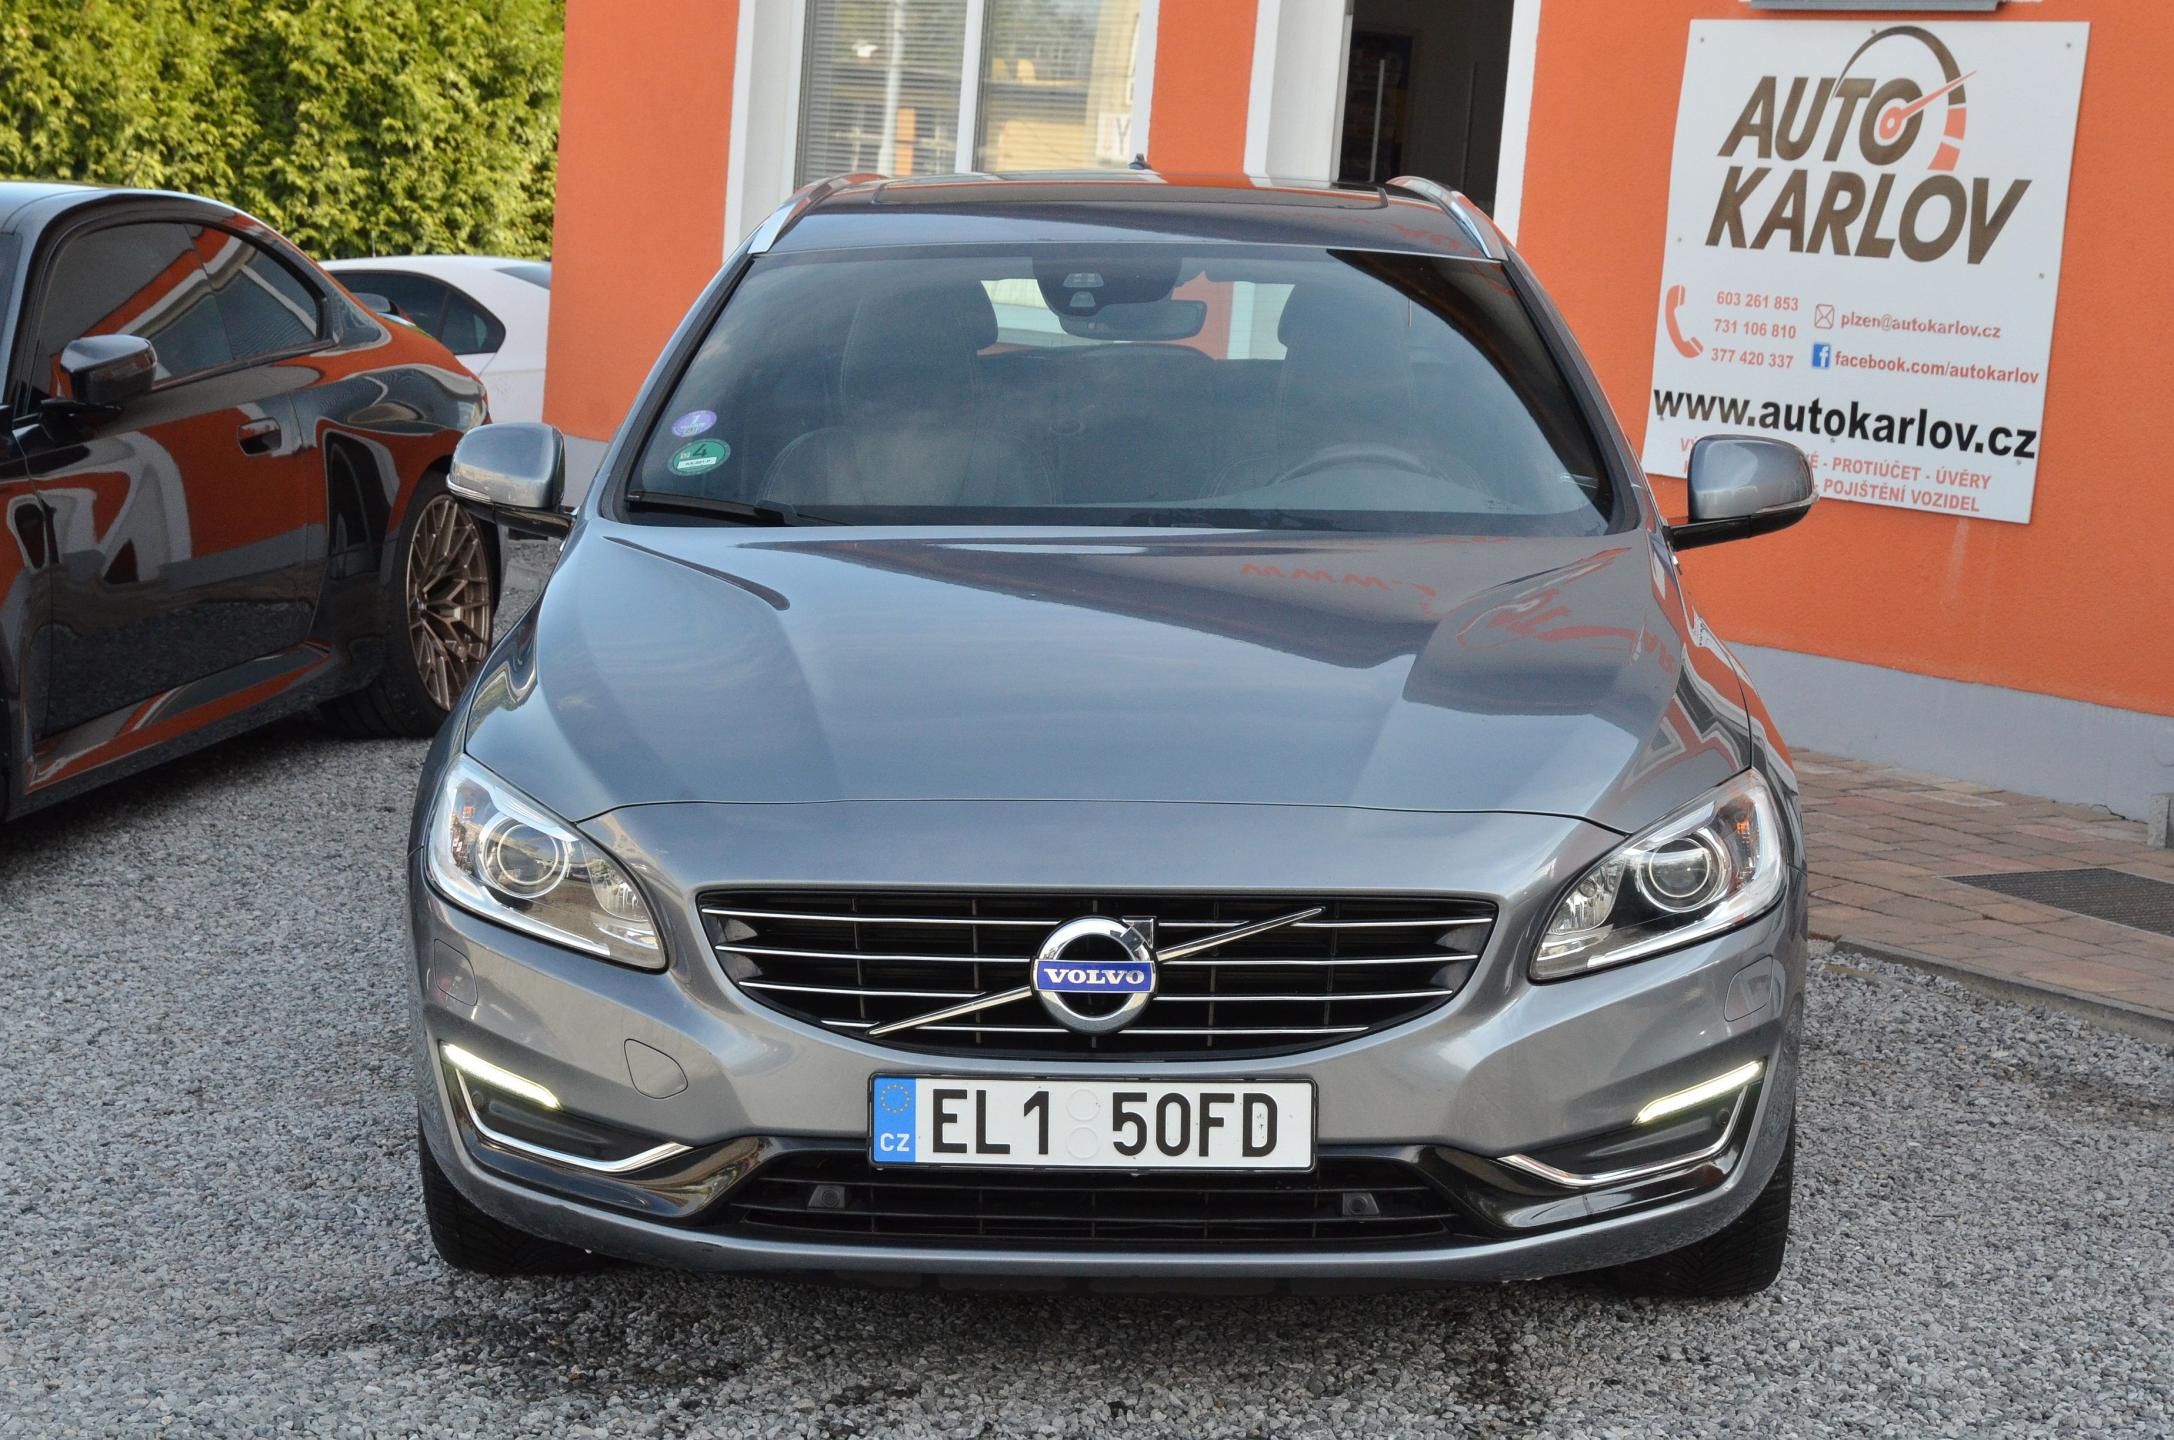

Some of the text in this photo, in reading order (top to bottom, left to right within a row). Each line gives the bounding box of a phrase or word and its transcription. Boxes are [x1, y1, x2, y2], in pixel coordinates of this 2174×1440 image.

[1717, 75, 1924, 166] AUTO
[1705, 166, 2032, 264] KARLOV
[1717, 291, 1799, 311] 603 261 853
[1714, 319, 1796, 339] 731 106 810
[1840, 312, 2001, 339] plzen@autokarlov.cz
[1711, 348, 1794, 368] 377 420 337
[1835, 351, 2039, 384] facebook.com/autokarlov
[1654, 389, 2037, 459] www.autokarlov.cz
[693, 443, 707, 457] 4
[1831, 456, 1922, 481] PROTIÚČET
[1935, 465, 1992, 490] ÚVĚRY
[1824, 479, 1980, 512] POJIŠTĚNÍ VOZIDEL
[1044, 967, 1145, 985] VOLVO
[880, 1133, 910, 1152] CZ
